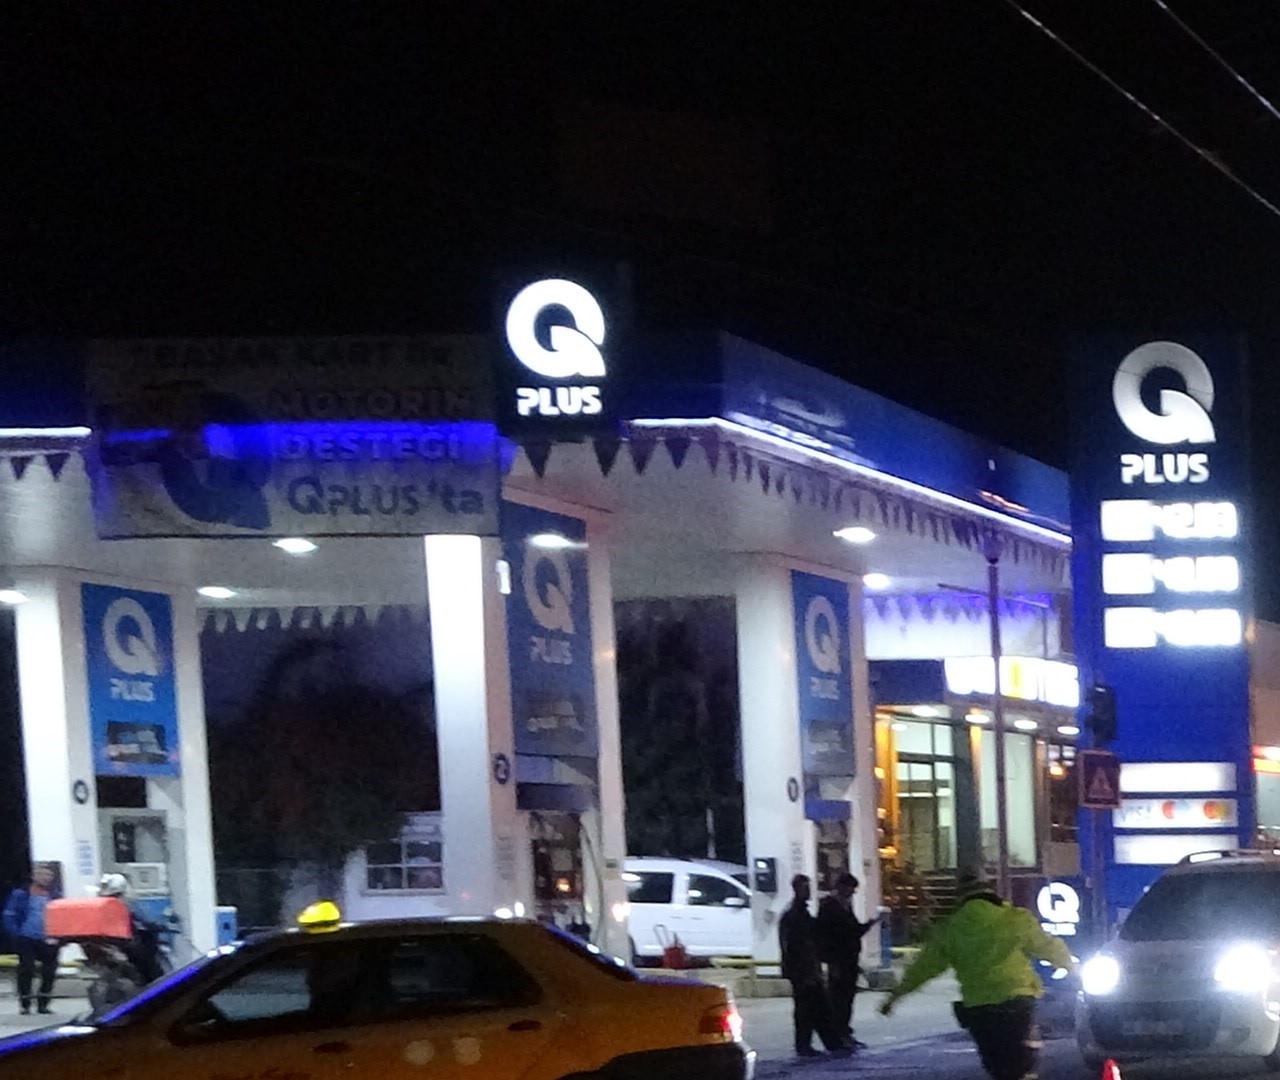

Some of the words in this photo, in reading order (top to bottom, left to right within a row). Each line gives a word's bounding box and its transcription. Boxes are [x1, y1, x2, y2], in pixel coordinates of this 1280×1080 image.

[506, 279, 606, 378] Q
[516, 386, 602, 416] PLUS
[1113, 341, 1216, 444] Q
[1121, 453, 1210, 483] PLUS
